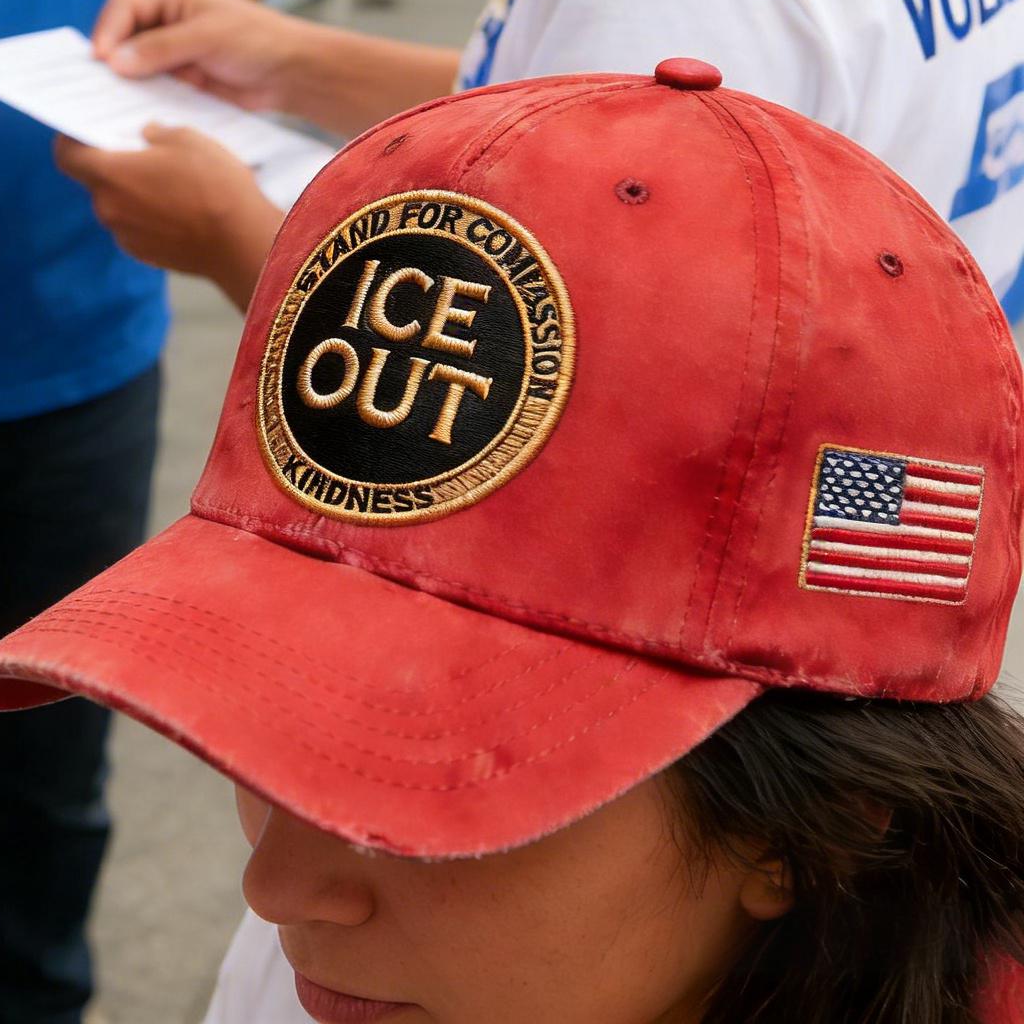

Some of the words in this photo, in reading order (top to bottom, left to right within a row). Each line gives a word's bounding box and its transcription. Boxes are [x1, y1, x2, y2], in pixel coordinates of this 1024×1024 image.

[296, 209, 391, 292] STAND
[399, 202, 464, 235] FOR
[341, 259, 493, 360] ICE
[295, 337, 494, 445] OUT
